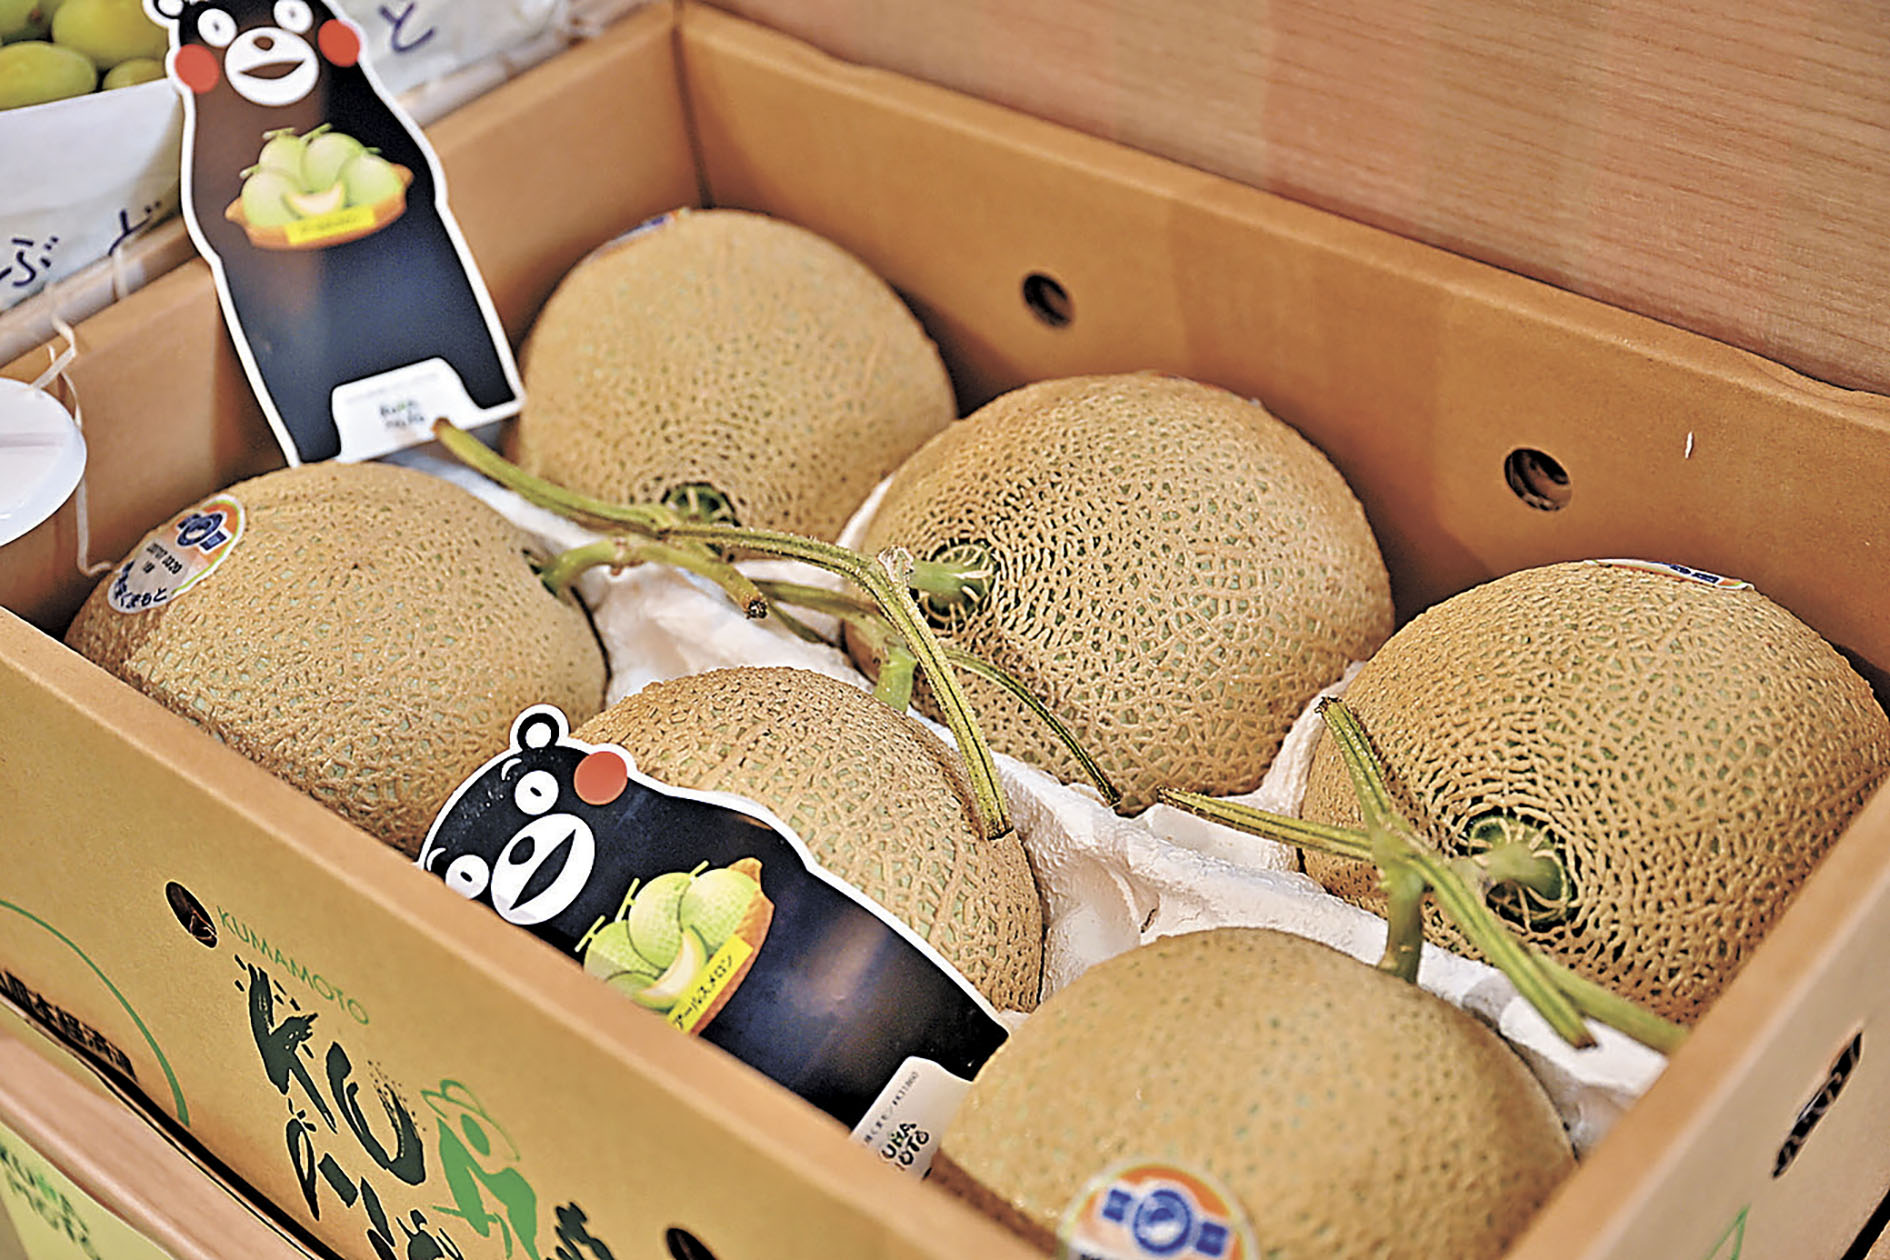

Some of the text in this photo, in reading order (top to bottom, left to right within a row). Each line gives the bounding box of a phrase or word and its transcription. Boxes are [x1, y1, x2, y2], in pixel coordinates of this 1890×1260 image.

[216, 904, 370, 1025] KUMAMOTO
[880, 1122, 918, 1160] UMA
[895, 1130, 931, 1172] OTO
